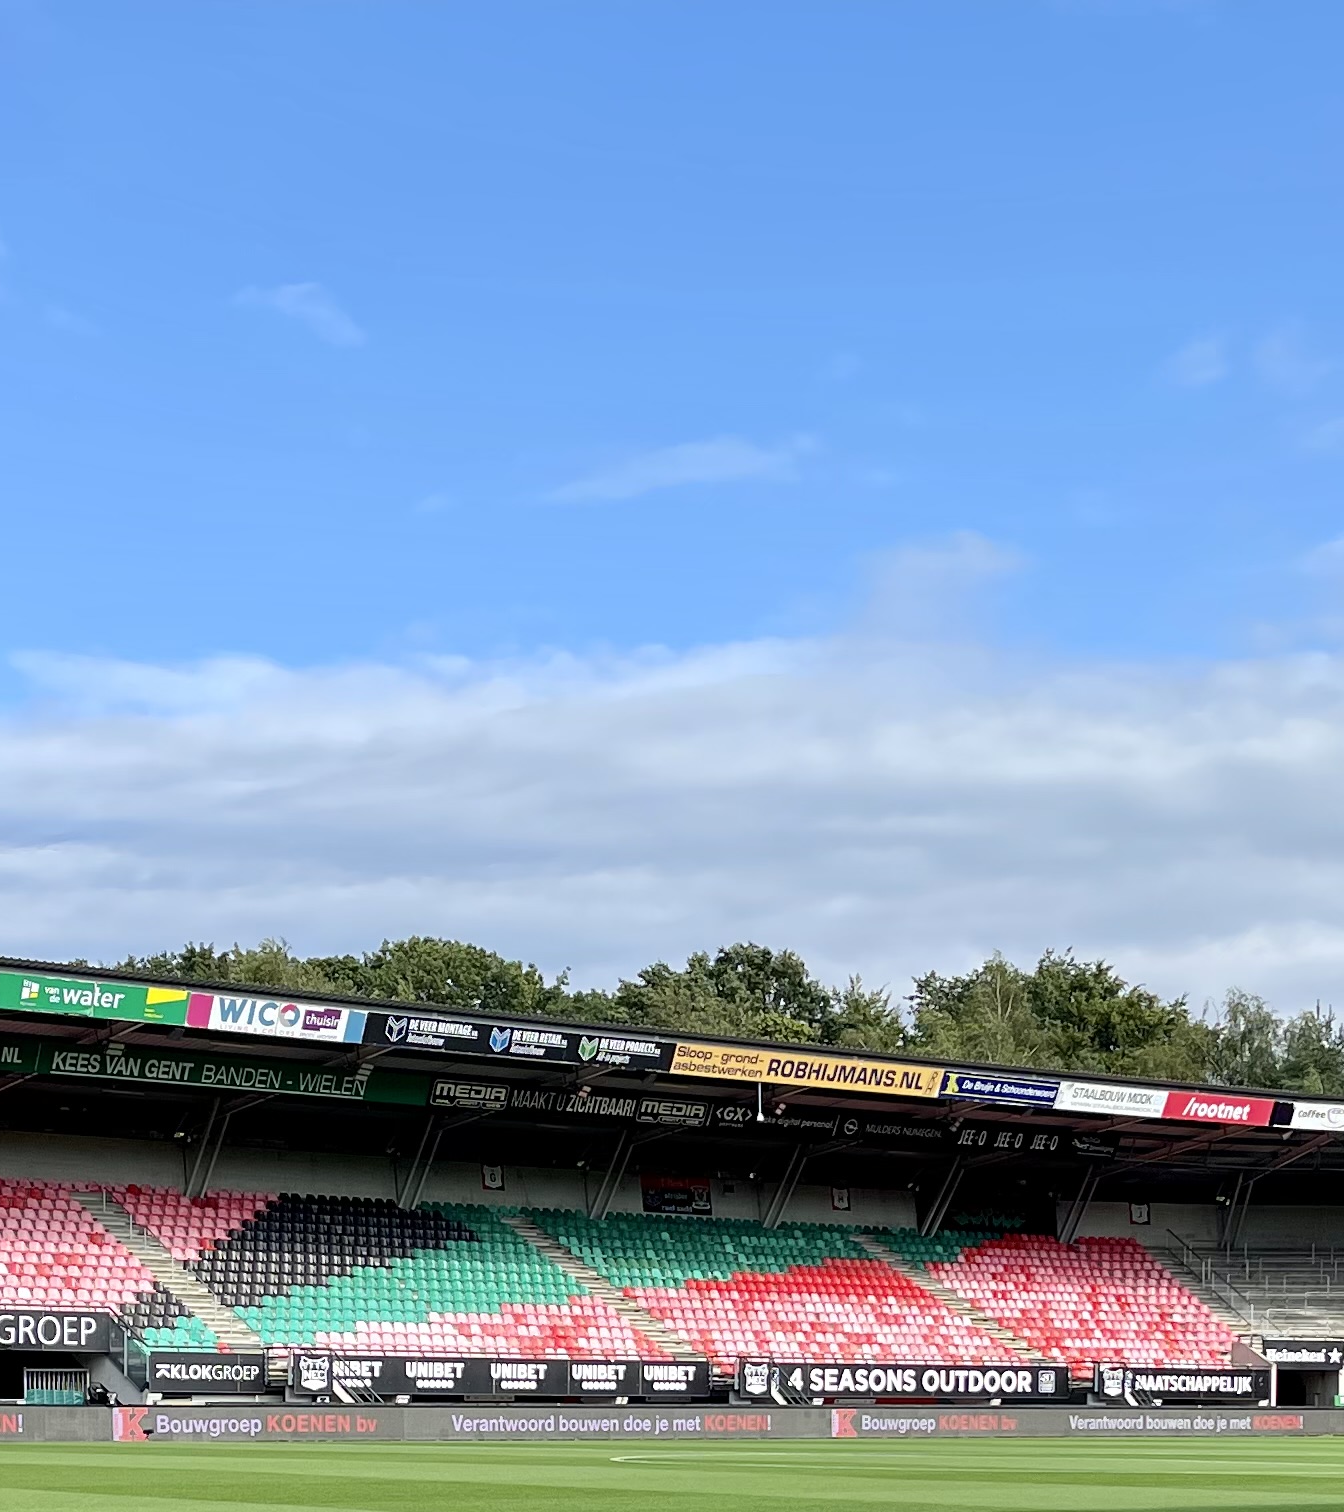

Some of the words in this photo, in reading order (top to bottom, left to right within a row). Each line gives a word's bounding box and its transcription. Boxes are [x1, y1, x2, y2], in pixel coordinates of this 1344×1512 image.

[62, 984, 126, 1010] water
[218, 996, 301, 1029] WICO
[676, 1045, 713, 1061] Sloop
[51, 1050, 102, 1074] KEES
[104, 1053, 143, 1076] VAN
[144, 1058, 195, 1082] GENT
[201, 1063, 284, 1091] BANDEN
[297, 1073, 367, 1098] WIELEN
[672, 1060, 763, 1080] asbestwerken
[766, 1057, 924, 1091] ROBHIJMANS.NL
[435, 1083, 507, 1101] MEDIA
[510, 1089, 556, 1111] MAAKT
[557, 1094, 567, 1110] U
[1072, 1087, 1127, 1103] STAALBOUW
[640, 1101, 705, 1118] MEDIA
[957, 1129, 988, 1147] JEE-O
[994, 1132, 1024, 1149] JEE-O
[1030, 1134, 1059, 1151] JEE-O
[1265, 1348, 1327, 1363] Heineken
[170, 1363, 260, 1381] KLOKGROEP
[406, 1361, 465, 1379] UNIBET
[490, 1363, 548, 1381] UNIBET
[572, 1364, 627, 1381] UNIBET
[644, 1365, 697, 1382] UNIBET
[788, 1367, 804, 1391] 4
[809, 1367, 917, 1394] SEASONS
[921, 1368, 1032, 1394] OUTDOOR
[155, 1414, 263, 1438] Bouwgroep
[266, 1413, 351, 1434] KOENEN
[355, 1413, 378, 1434] bv
[451, 1414, 555, 1432] Verantwoord
[558, 1415, 620, 1432] bouwen
[623, 1415, 652, 1432] doe
[654, 1415, 669, 1435] je
[672, 1416, 701, 1432] met
[704, 1414, 772, 1432] KOENEN!
[861, 1414, 937, 1434] Bouwgroep
[938, 1414, 998, 1431] KOENEN
[1000, 1414, 1018, 1431] bv
[1069, 1414, 1144, 1431] Verantwoord
[1146, 1415, 1191, 1430] bouwen
[1192, 1415, 1215, 1430] doe
[1216, 1415, 1228, 1433] je
[1230, 1415, 1252, 1430] met
[1252, 1414, 1304, 1430] KOENEN!
